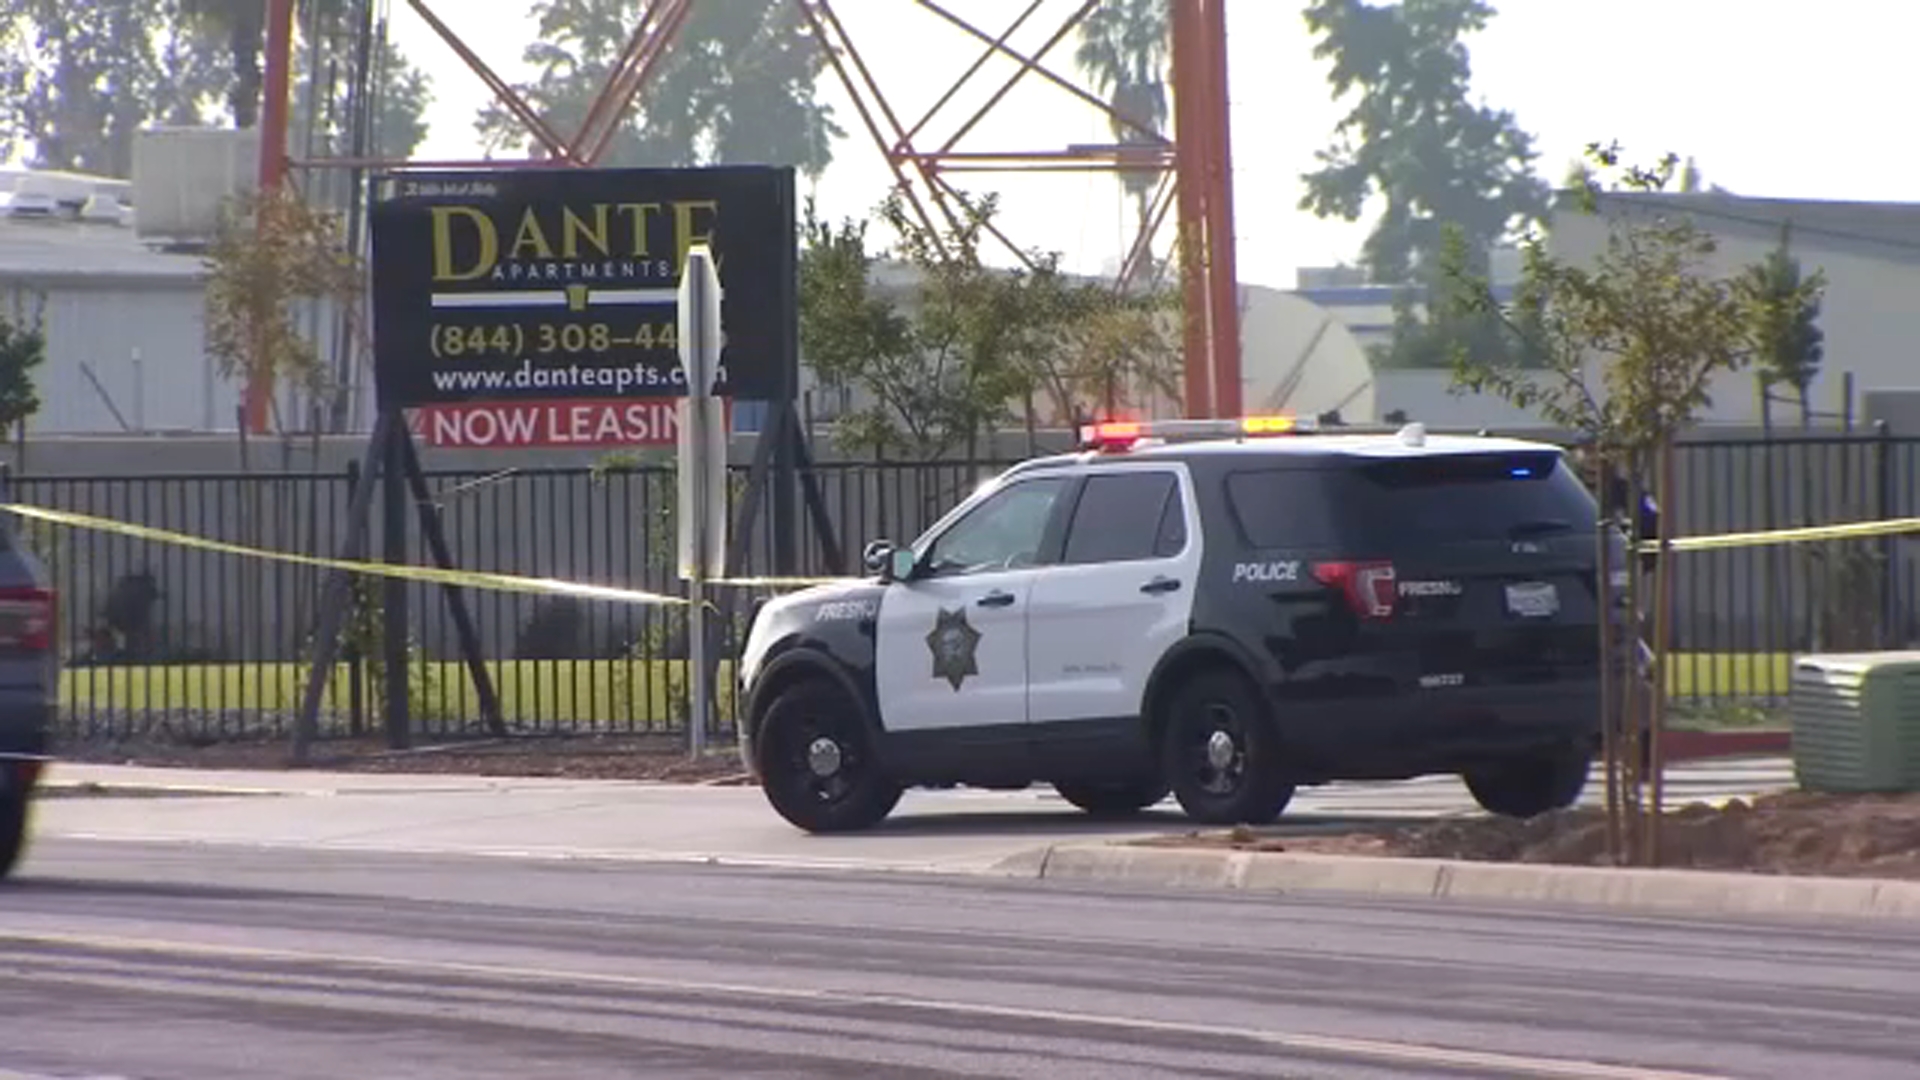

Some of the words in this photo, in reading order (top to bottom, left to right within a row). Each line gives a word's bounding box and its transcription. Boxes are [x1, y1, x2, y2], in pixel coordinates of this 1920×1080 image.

[431, 201, 724, 281] DANTE
[491, 260, 672, 281] APARTMENTS
[430, 324, 524, 357] (844)
[538, 322, 729, 352] 308-44
[432, 360, 728, 393] www.danteapts.c
[433, 407, 539, 445] NOW
[548, 402, 681, 442] LEASIN
[1232, 561, 1300, 582] POLICE
